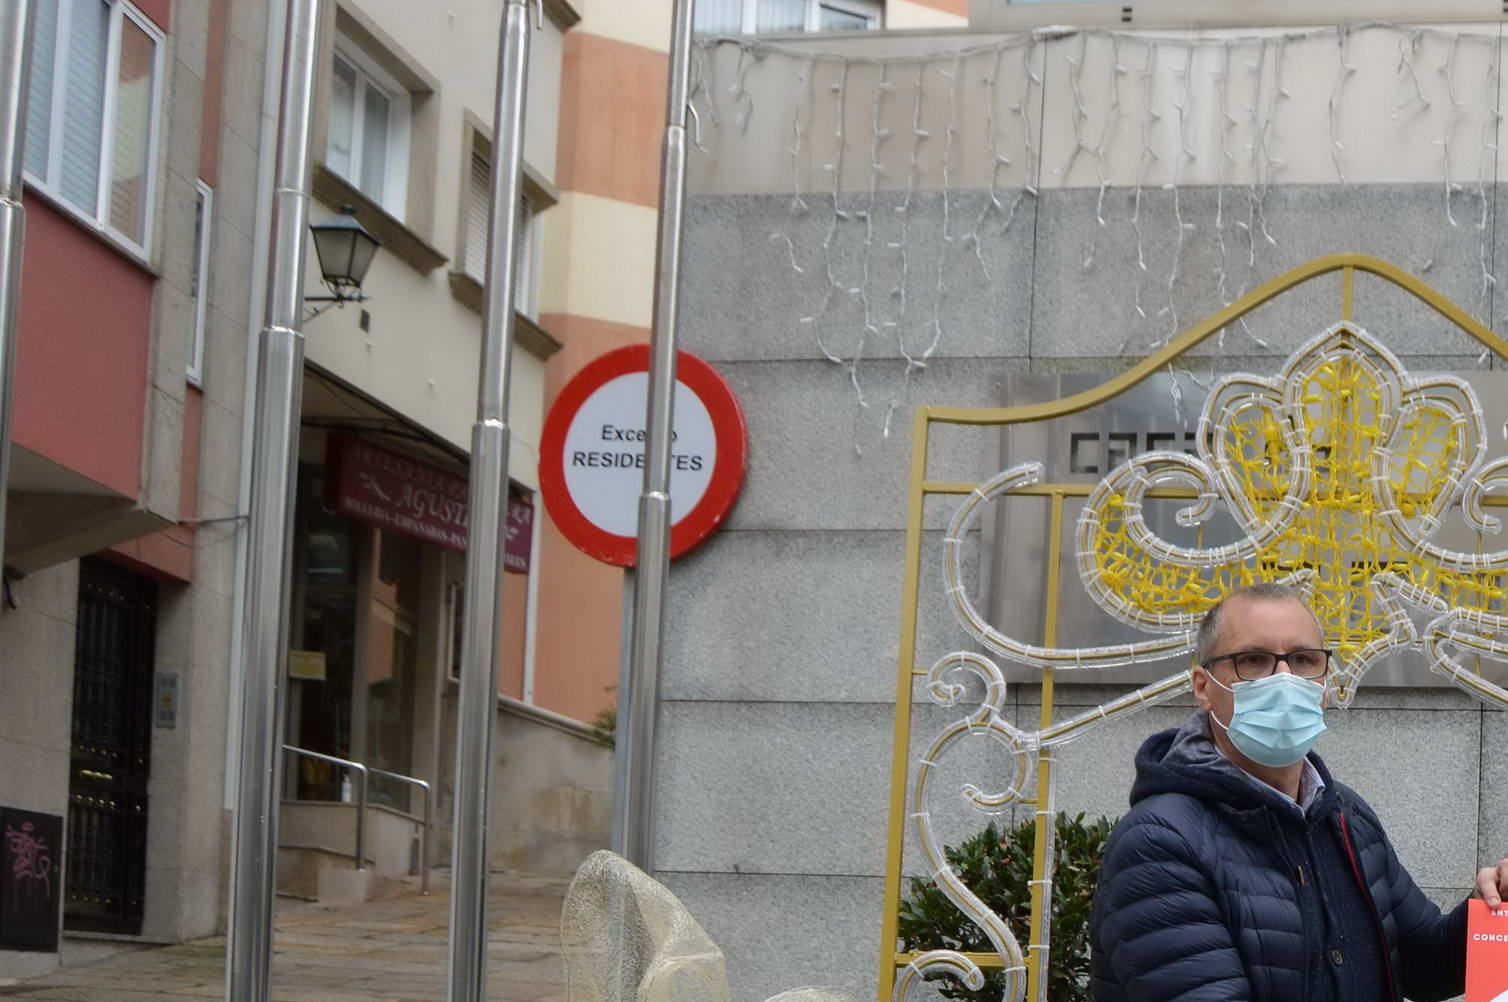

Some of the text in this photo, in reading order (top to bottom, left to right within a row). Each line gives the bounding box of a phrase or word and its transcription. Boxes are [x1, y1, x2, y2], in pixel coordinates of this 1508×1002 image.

[601, 424, 678, 442] Exce
[573, 451, 703, 471] RESIDEES
[394, 483, 469, 527] AGUSTI
